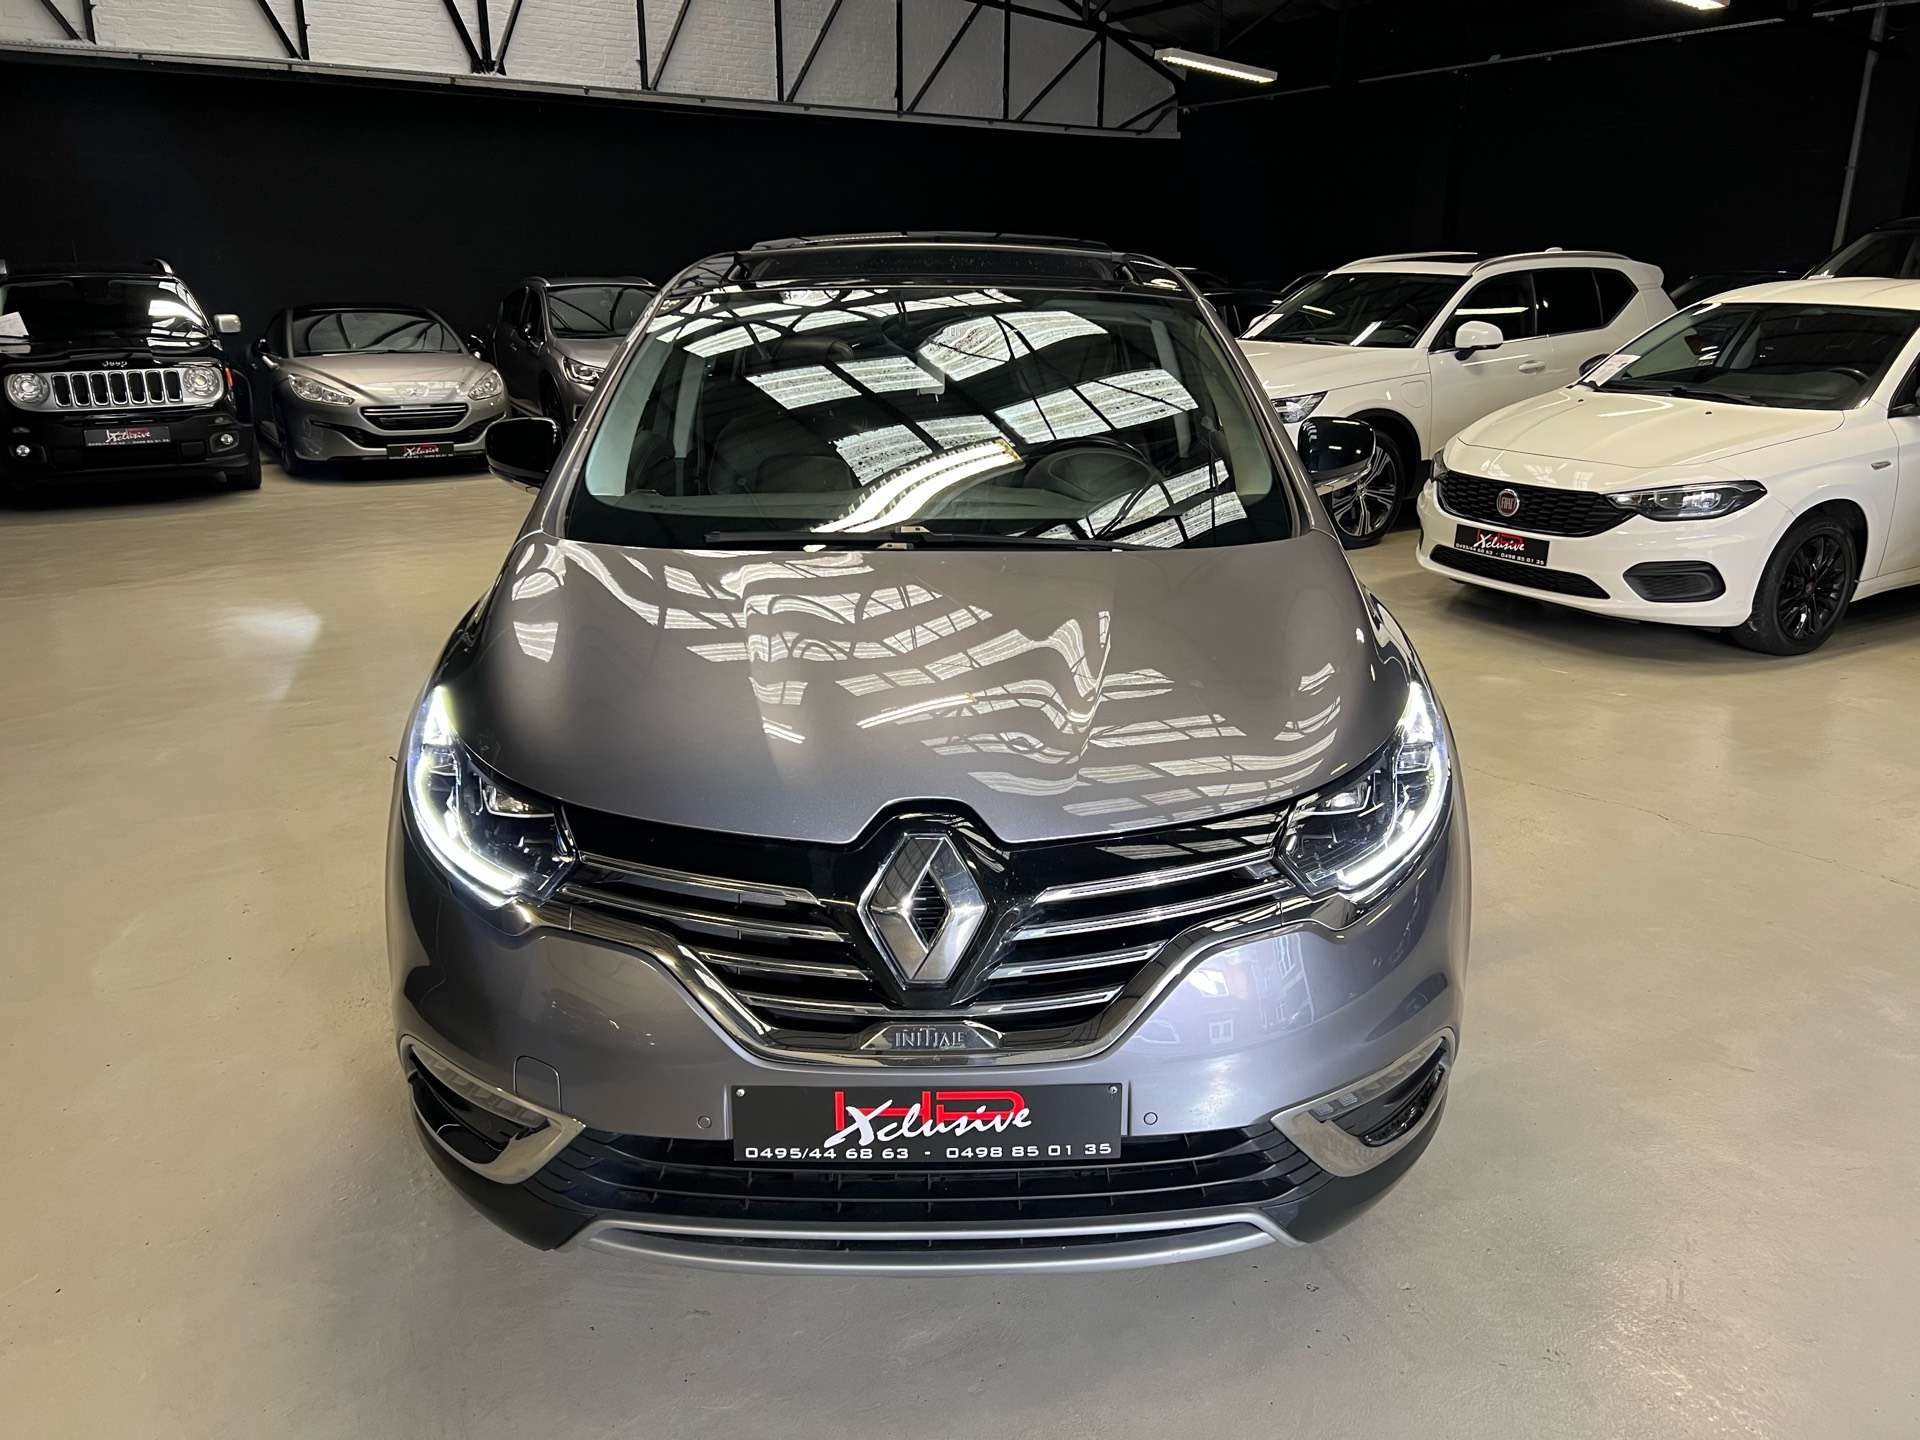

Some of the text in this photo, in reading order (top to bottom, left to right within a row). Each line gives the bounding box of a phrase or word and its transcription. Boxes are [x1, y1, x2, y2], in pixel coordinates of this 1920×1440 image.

[1501, 497, 1514, 509] FIAT
[1473, 534, 1525, 551] Xclusive
[895, 1028, 966, 1049] INITIALE
[823, 1099, 1032, 1148] Xclusive
[745, 1147, 837, 1160] 0495/44
[845, 1148, 873, 1159] 68
[882, 1147, 909, 1159] 63
[946, 1146, 1003, 1159] 0498
[1011, 1145, 1039, 1157] 85
[1048, 1144, 1072, 1156] 01
[1084, 1143, 1112, 1155] 35
